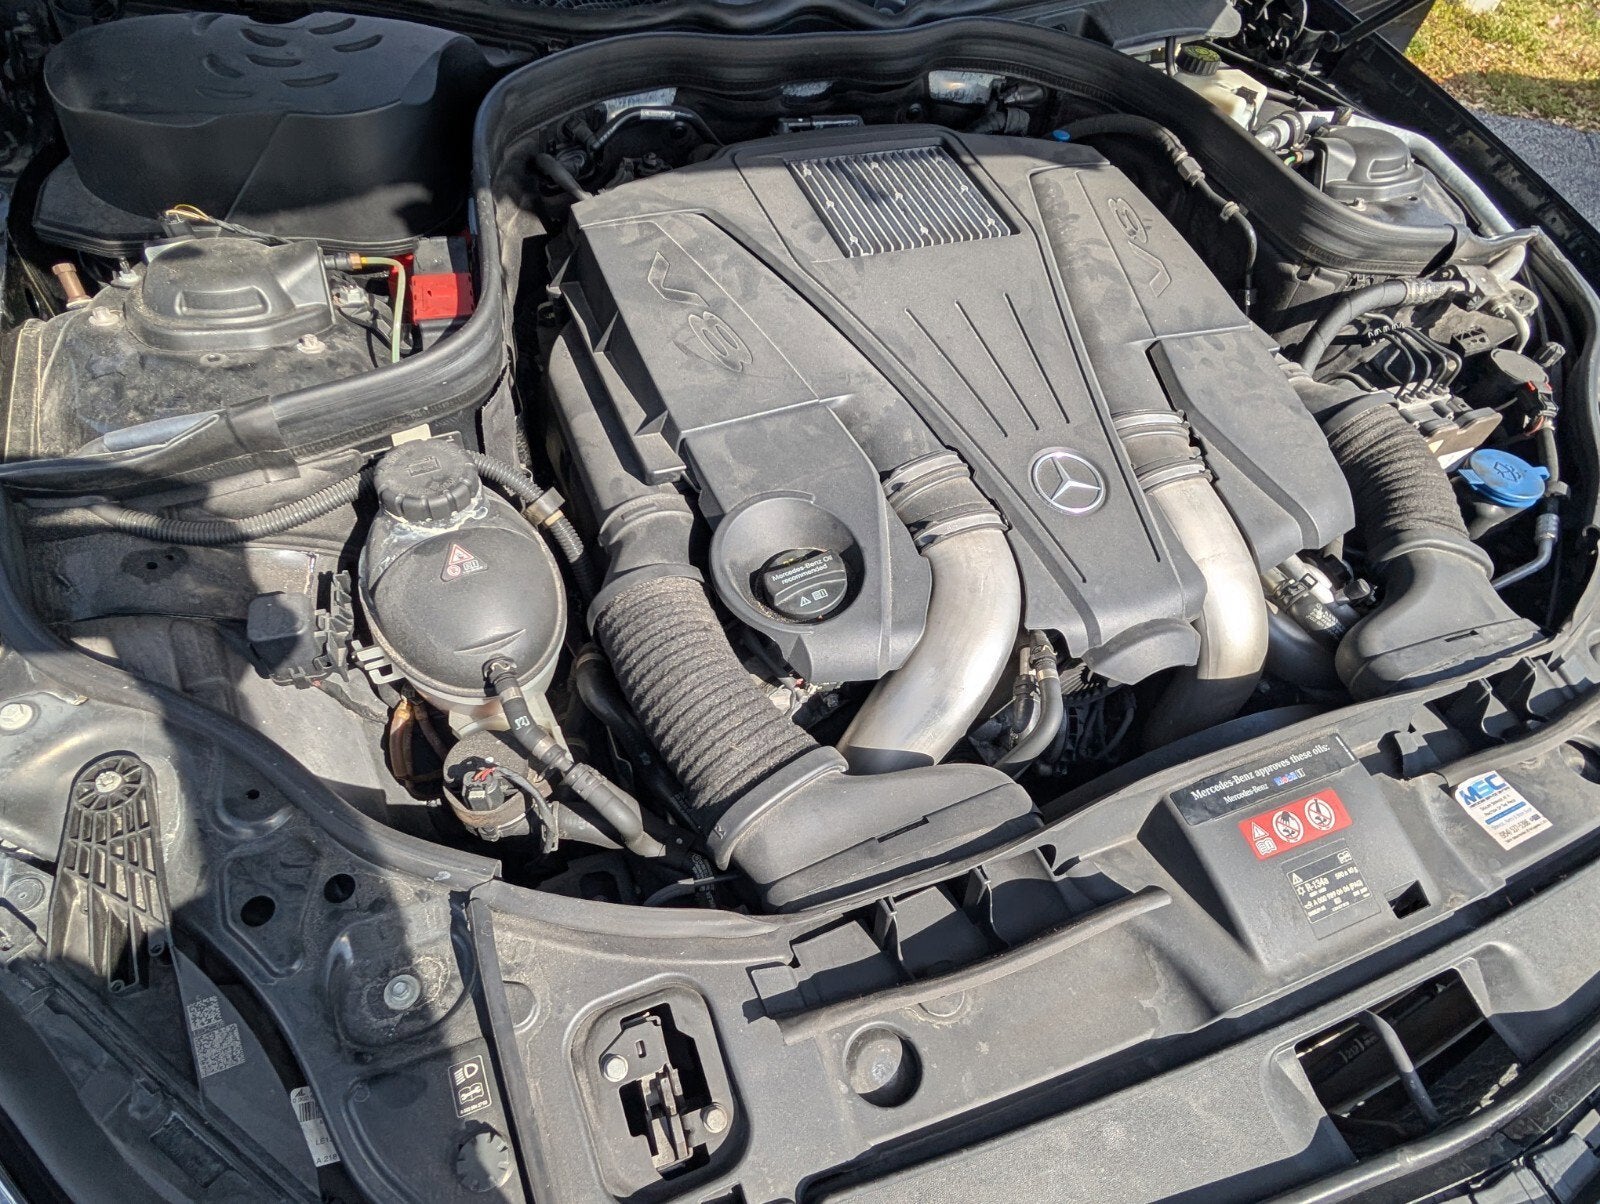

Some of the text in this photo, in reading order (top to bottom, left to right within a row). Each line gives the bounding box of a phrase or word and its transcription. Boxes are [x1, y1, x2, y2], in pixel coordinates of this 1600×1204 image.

[771, 559, 822, 580] Mercedes-Benz
[781, 563, 827, 584] recommended
[1190, 770, 1254, 800] Mercedes-Benz
[1254, 758, 1290, 779] approves
[1291, 750, 1312, 764] these
[1312, 742, 1330, 756] oils:
[1222, 782, 1268, 804] Mercedes-Benz
[1304, 876, 1329, 893] R-134a
